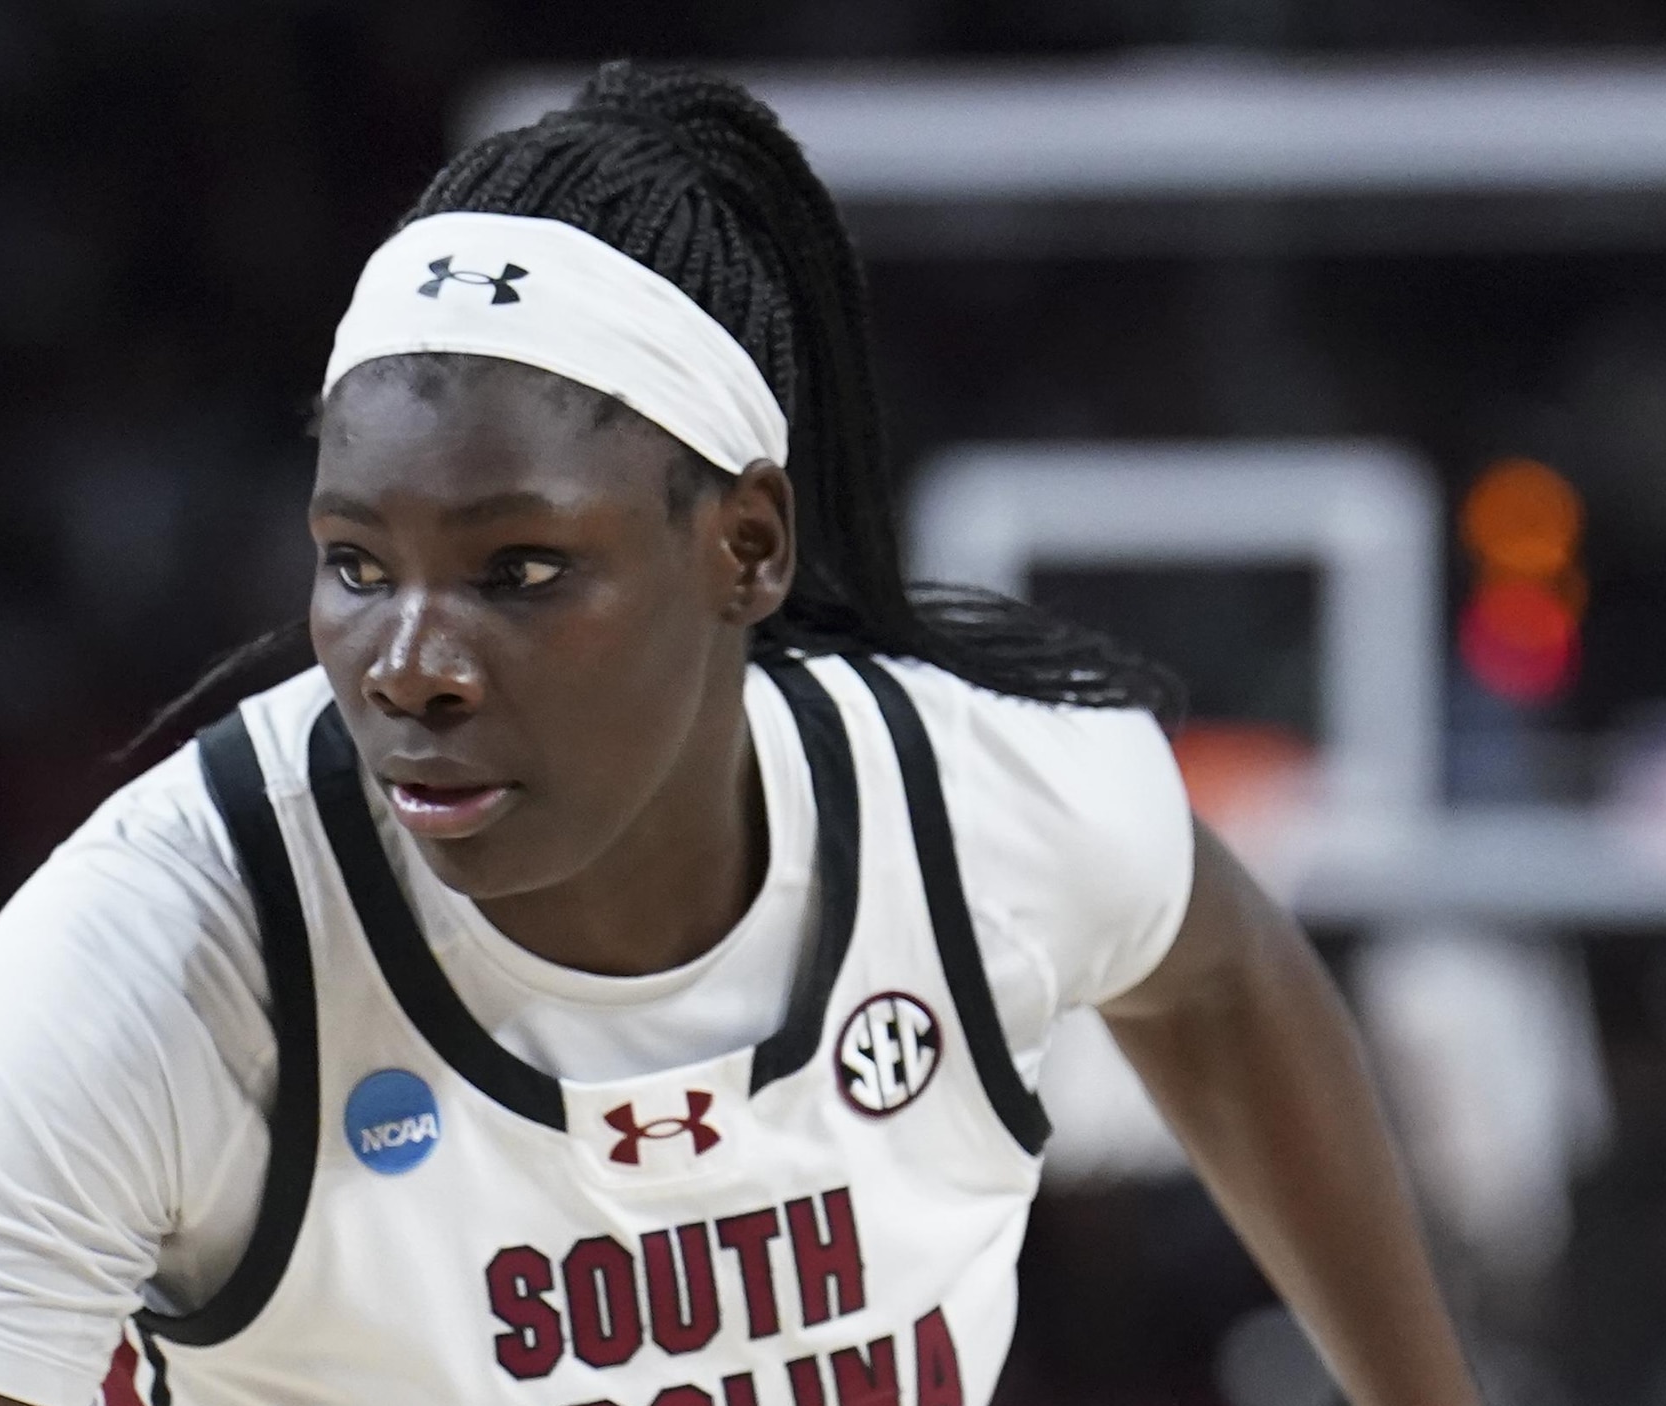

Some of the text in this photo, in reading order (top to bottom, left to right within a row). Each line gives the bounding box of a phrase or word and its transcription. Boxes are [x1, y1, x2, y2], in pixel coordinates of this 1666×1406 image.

[841, 998, 935, 1111] SEC
[360, 1112, 439, 1154] NCAA
[485, 1186, 868, 1380] SOUTH
